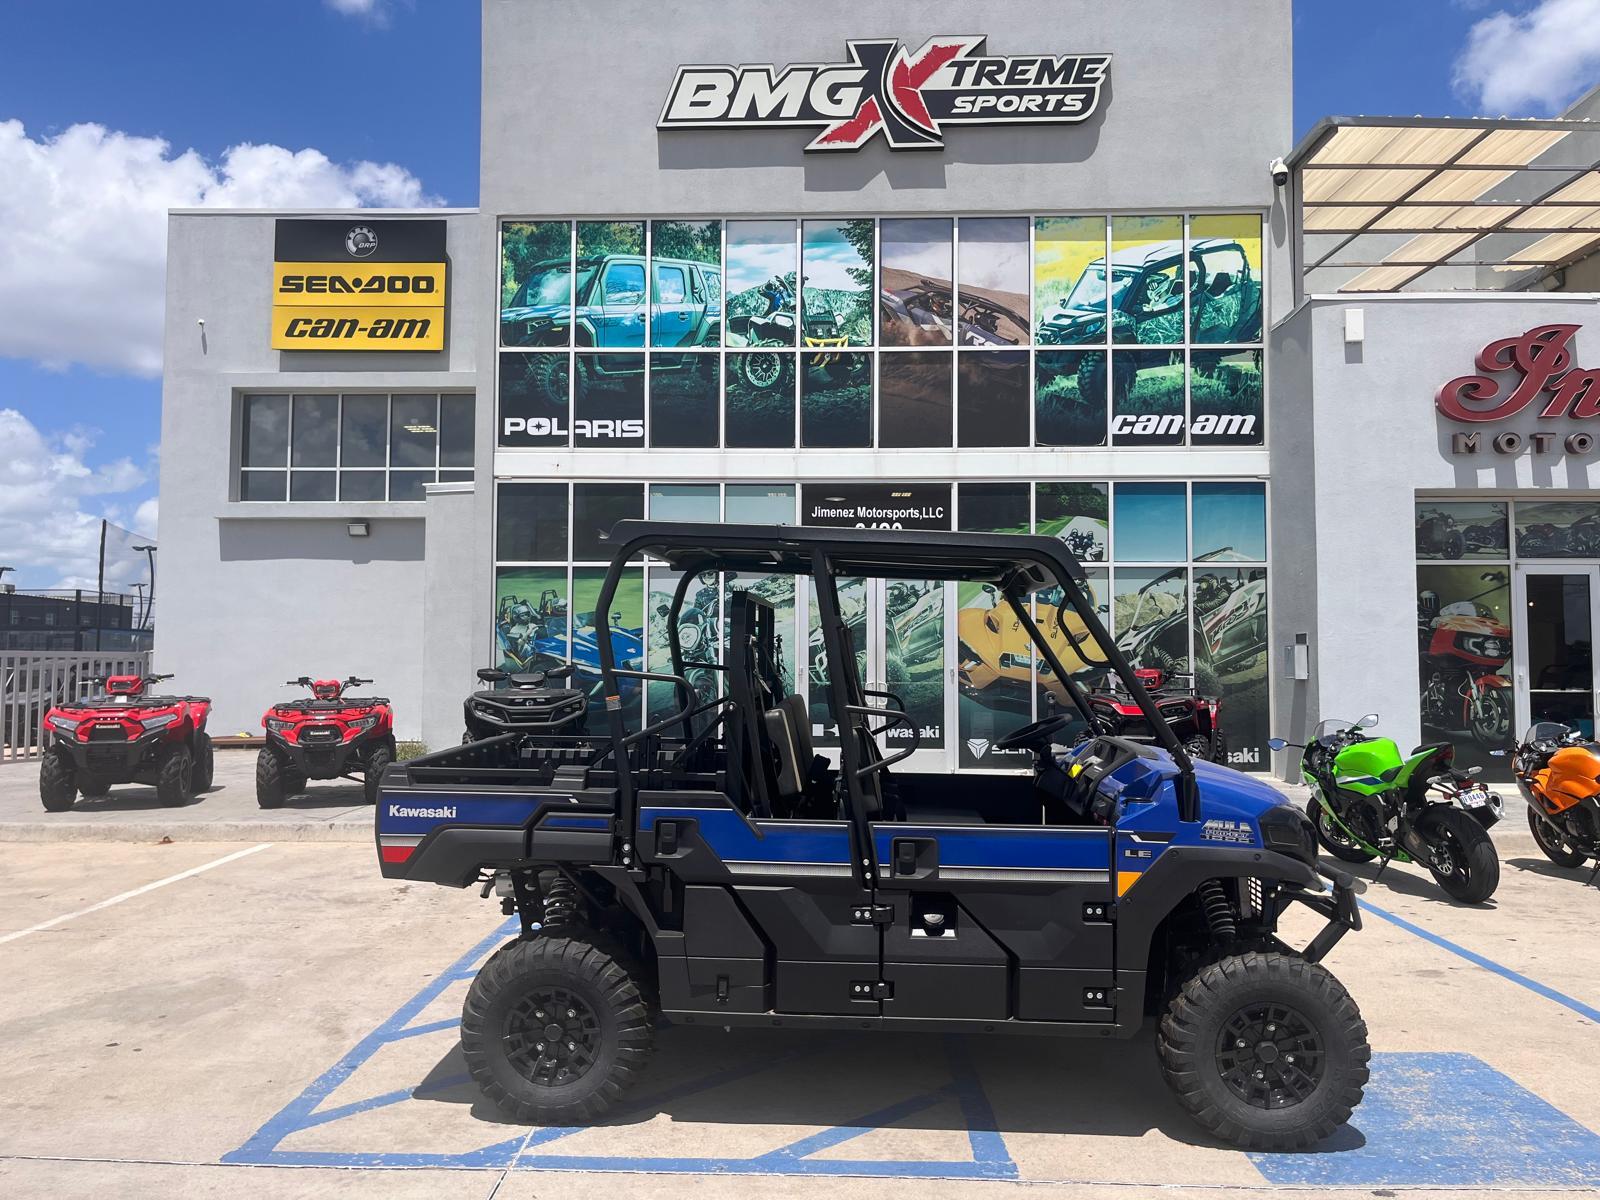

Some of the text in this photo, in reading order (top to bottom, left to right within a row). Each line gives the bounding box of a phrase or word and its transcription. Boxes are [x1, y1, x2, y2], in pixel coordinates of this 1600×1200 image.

[667, 68, 869, 119] BMG
[950, 95, 1083, 114] SPORTS
[504, 417, 644, 439] POLARIS
[811, 506, 855, 518] Jimenez
[388, 804, 457, 818] Kawasaki
[1124, 848, 1153, 858] LE
